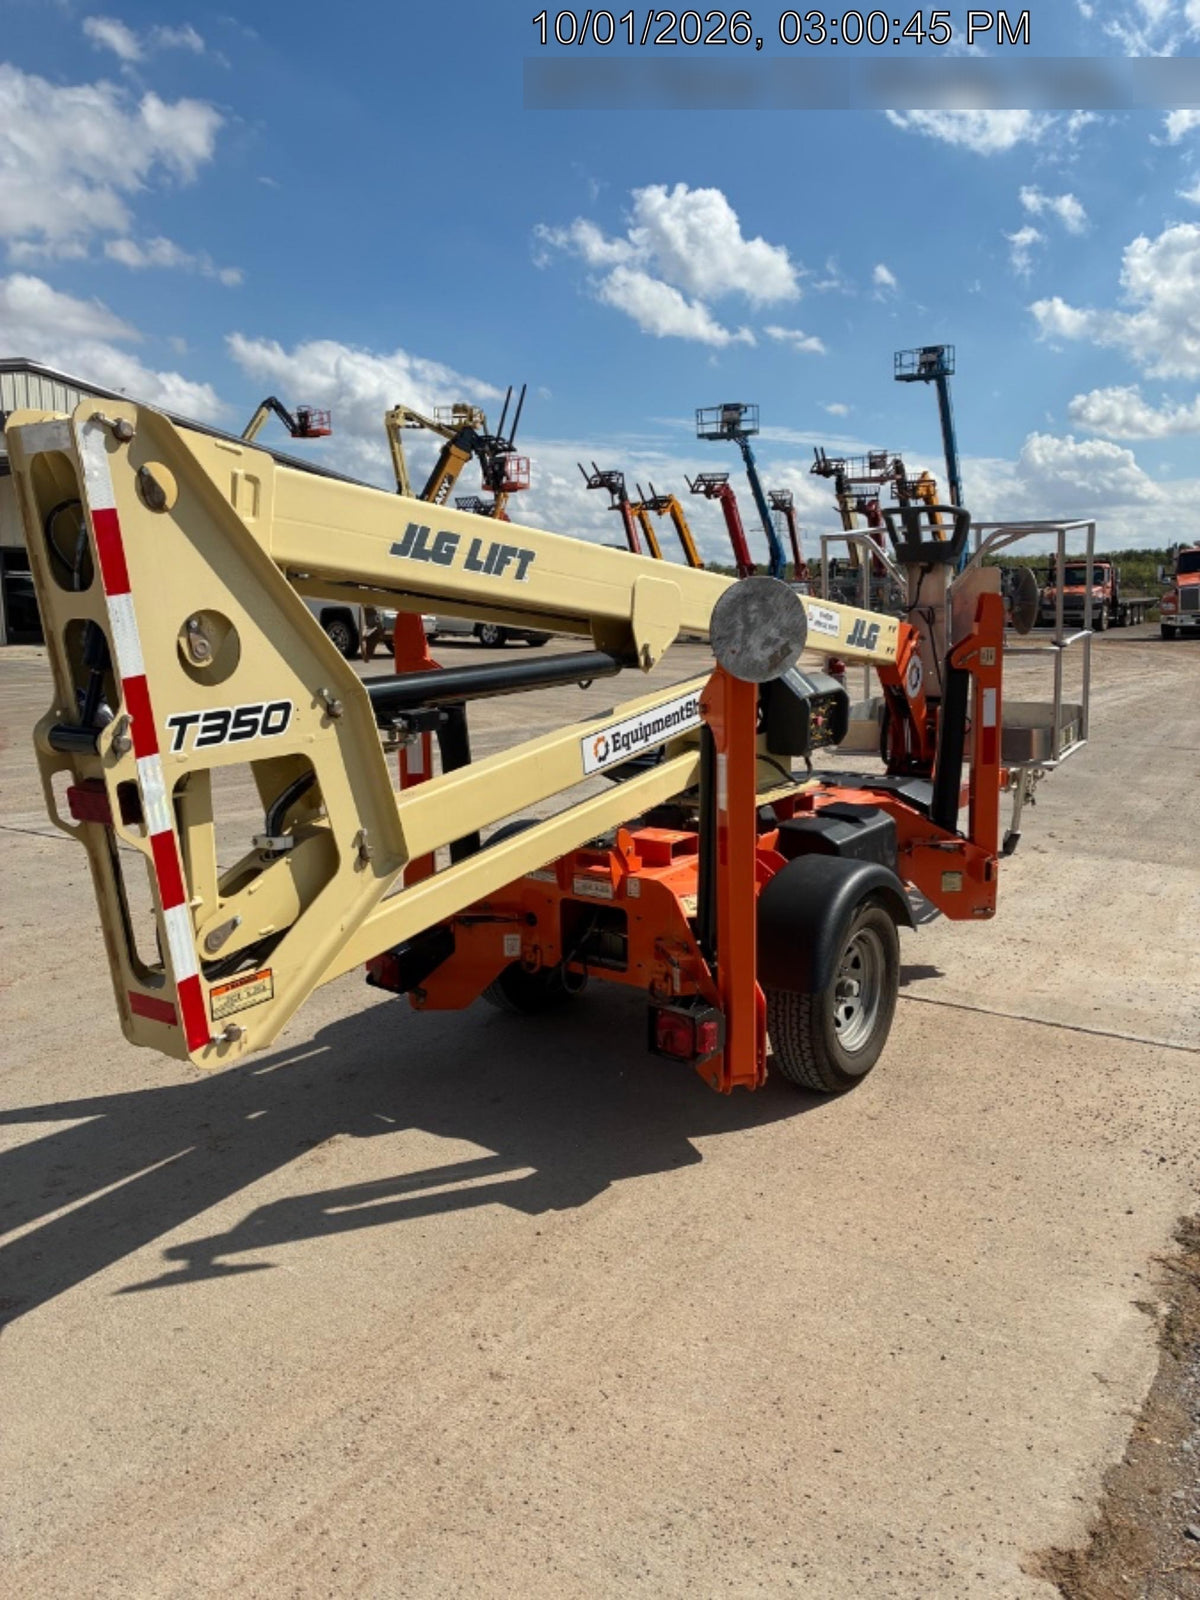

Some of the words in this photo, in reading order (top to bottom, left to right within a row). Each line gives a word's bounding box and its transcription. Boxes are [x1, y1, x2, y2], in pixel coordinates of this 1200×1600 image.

[389, 522, 461, 566] JLG
[463, 537, 536, 581] LIFT
[846, 618, 881, 651] JLG
[168, 701, 292, 751] T350
